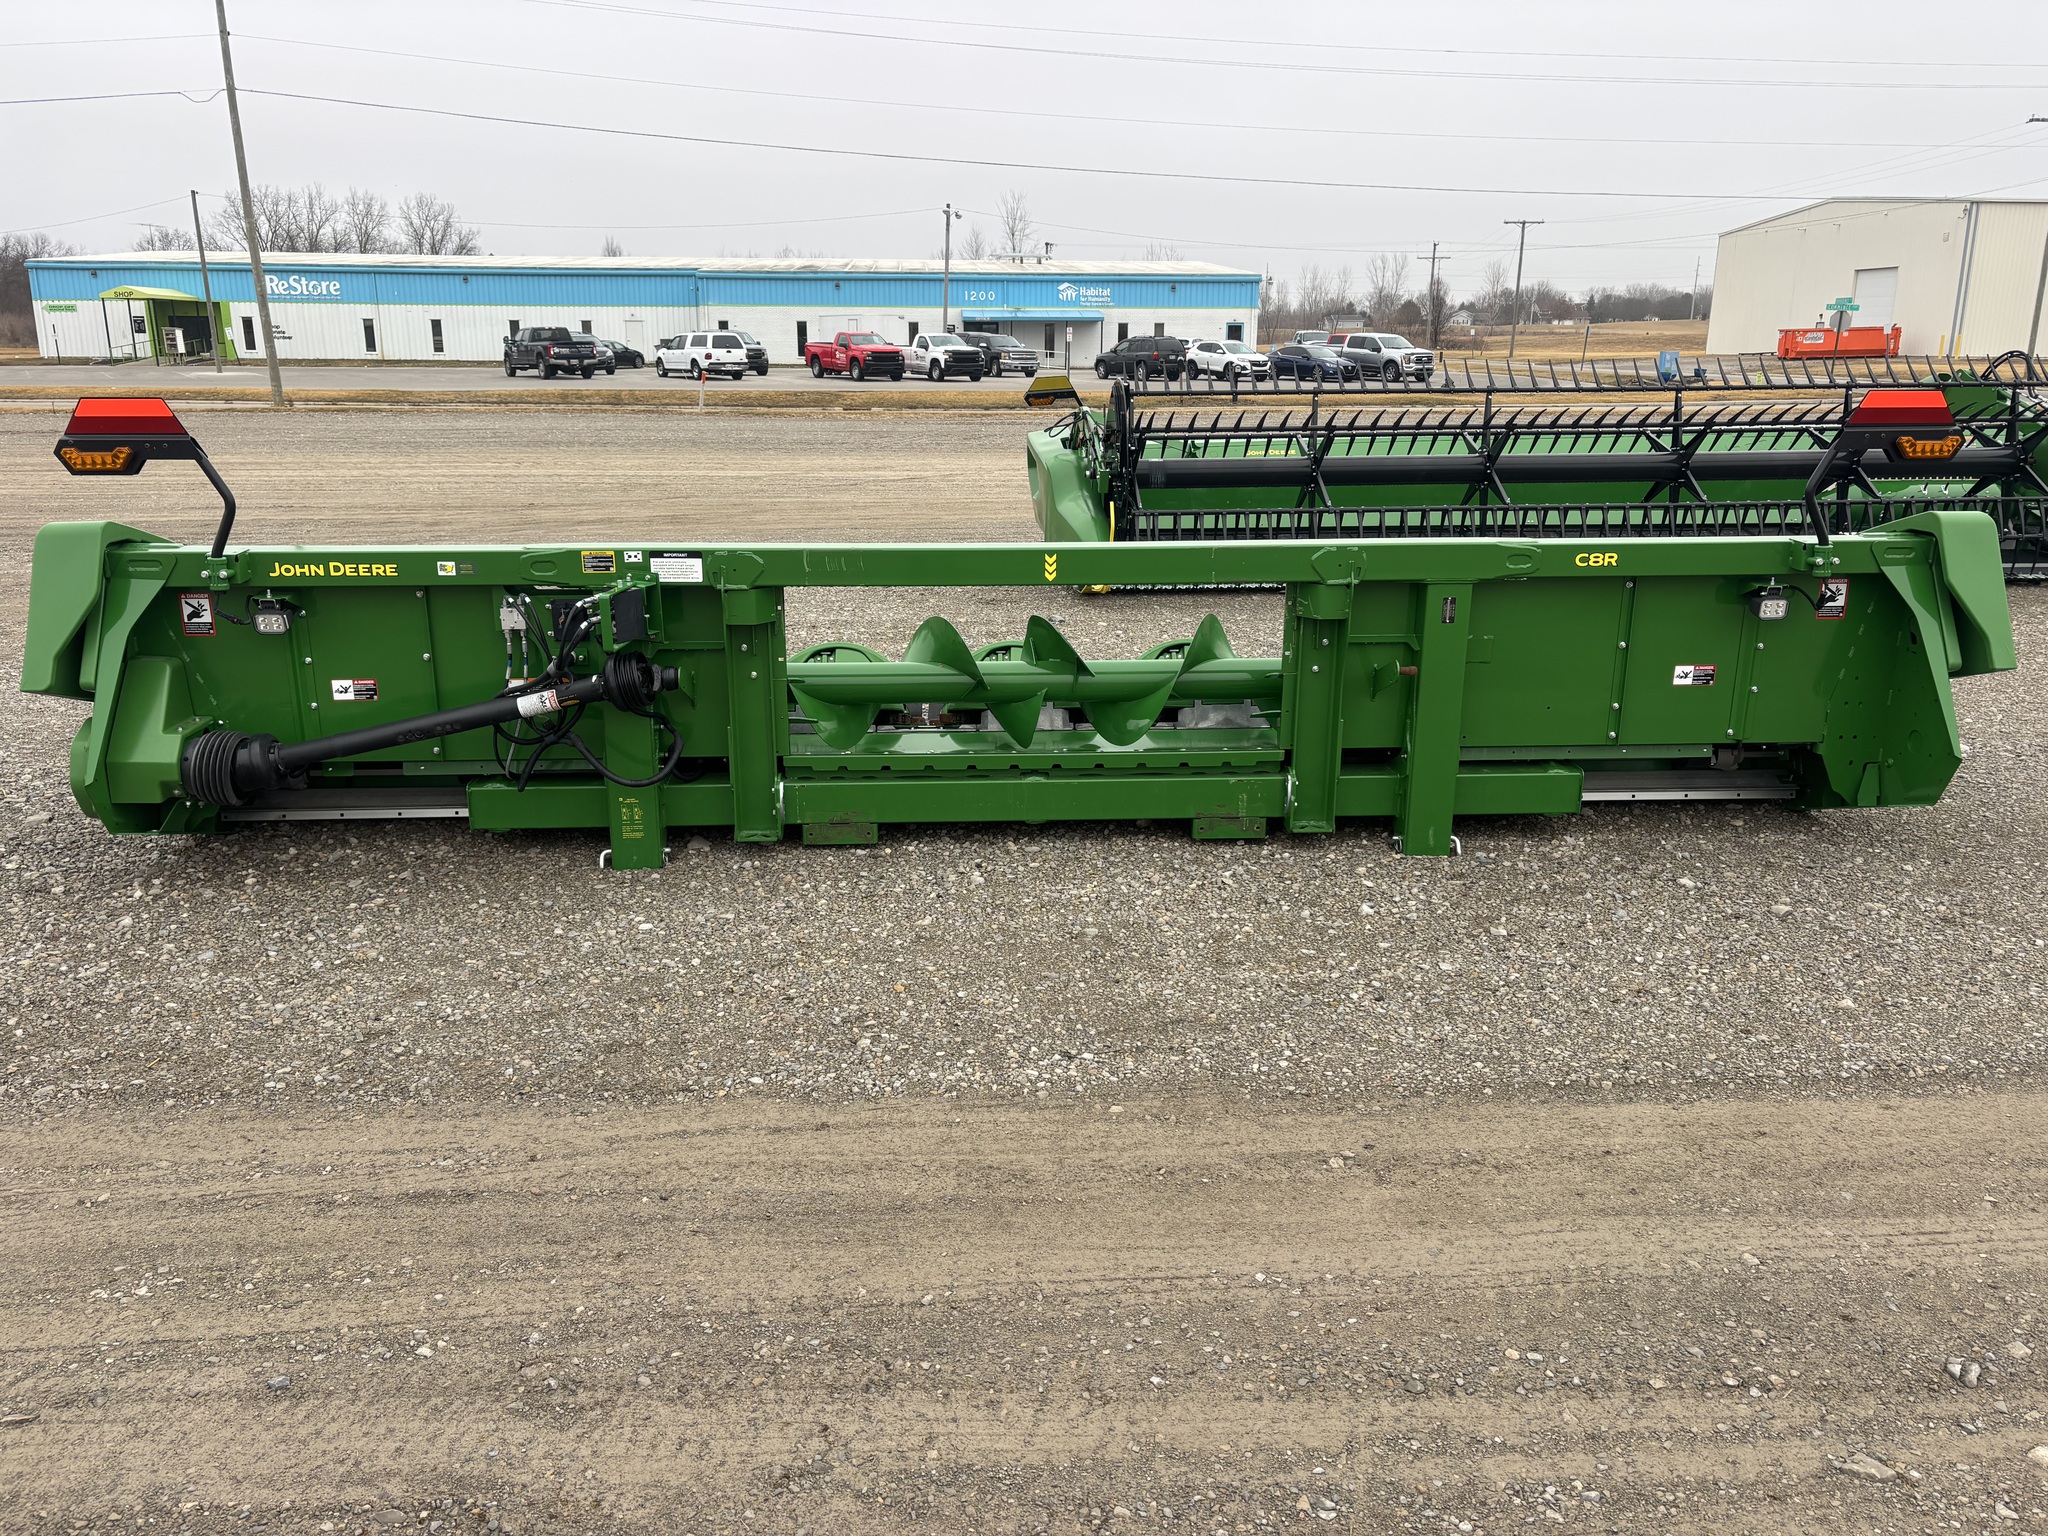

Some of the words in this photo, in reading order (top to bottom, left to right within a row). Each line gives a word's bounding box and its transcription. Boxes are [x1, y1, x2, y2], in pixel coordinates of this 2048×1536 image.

[264, 275, 341, 295] ReStore
[1080, 287, 1111, 296] Habitat
[964, 291, 996, 301] 1200
[1575, 552, 1619, 567] C8R
[269, 562, 325, 577] JOHN
[328, 561, 399, 577] DEERE
